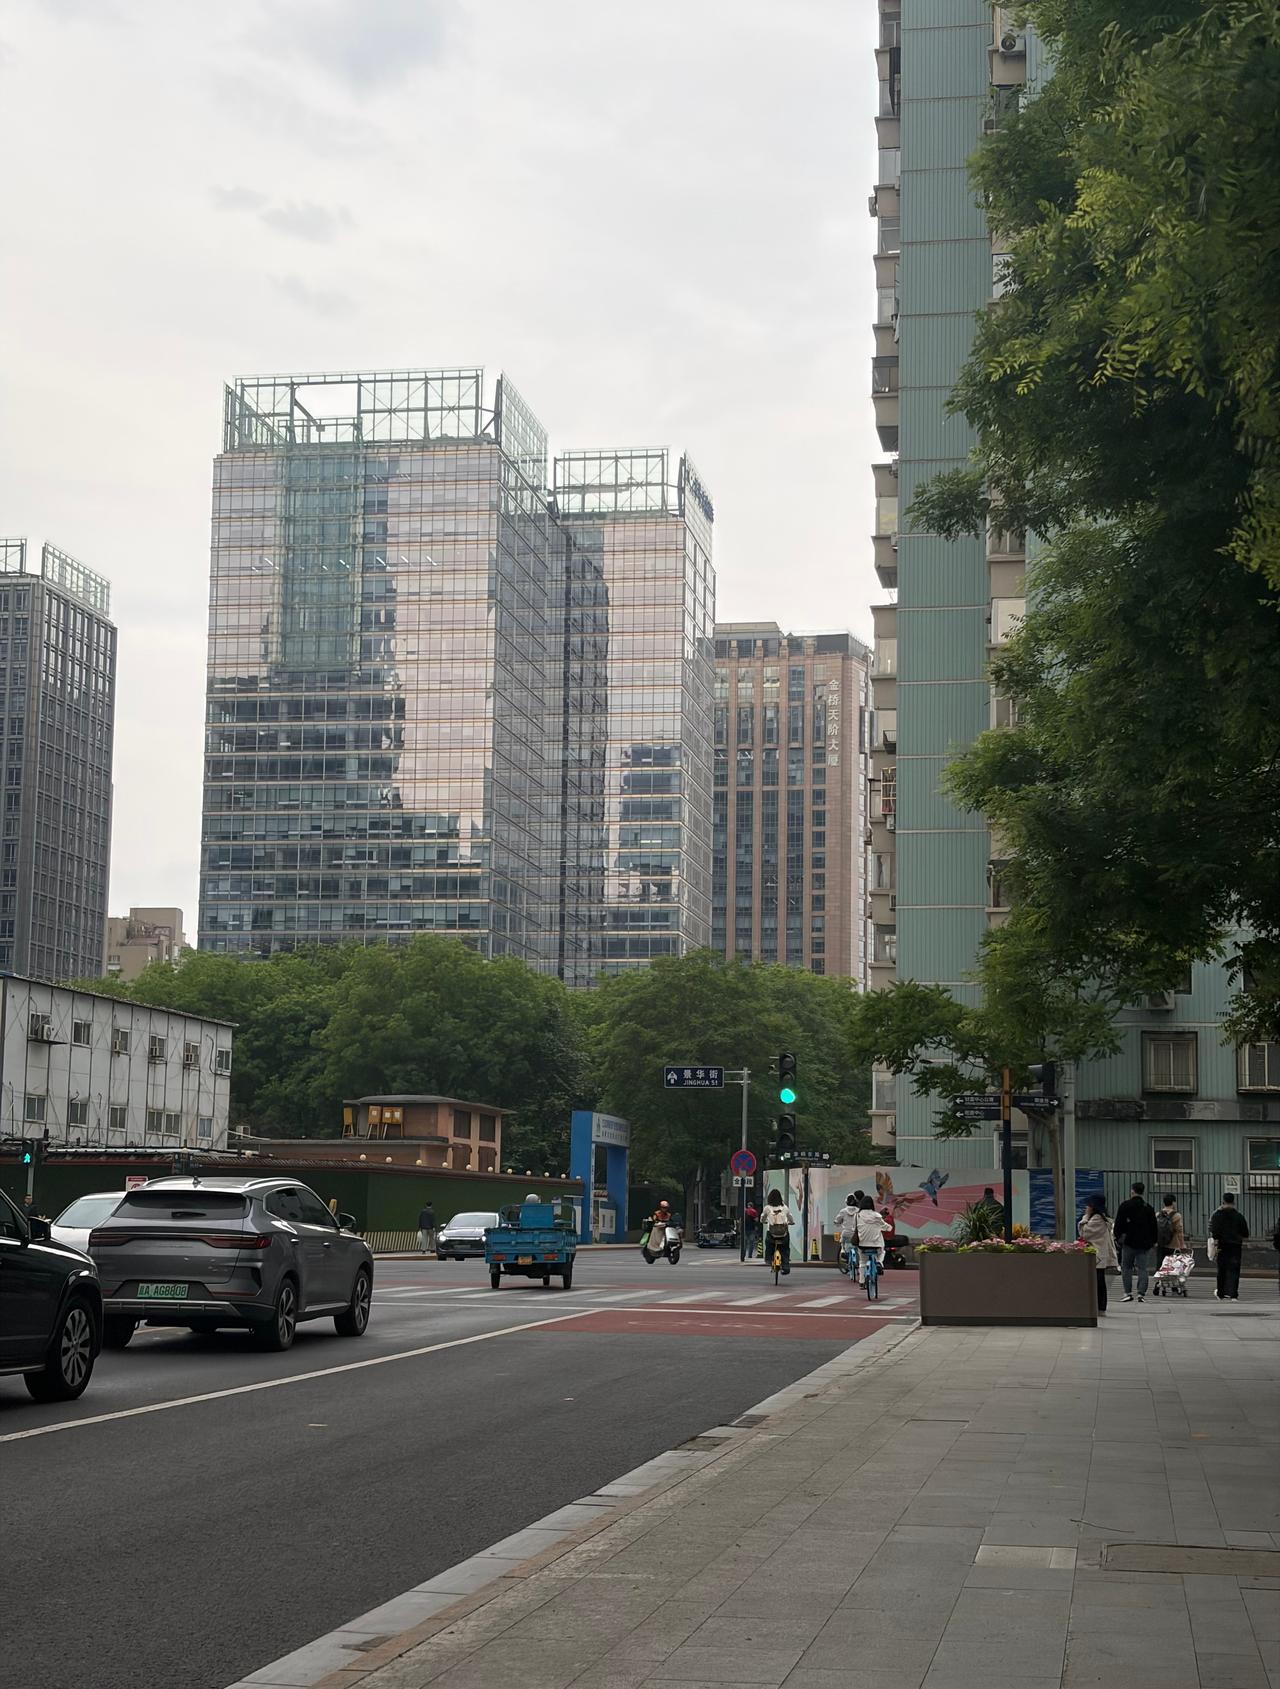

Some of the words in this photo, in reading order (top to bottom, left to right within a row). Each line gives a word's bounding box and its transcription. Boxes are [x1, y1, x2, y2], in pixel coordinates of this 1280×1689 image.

[828, 679, 840, 767] 金桥天阶大厦
[683, 1069, 718, 1079] 景华街
[734, 1177, 752, 1185] 全段
